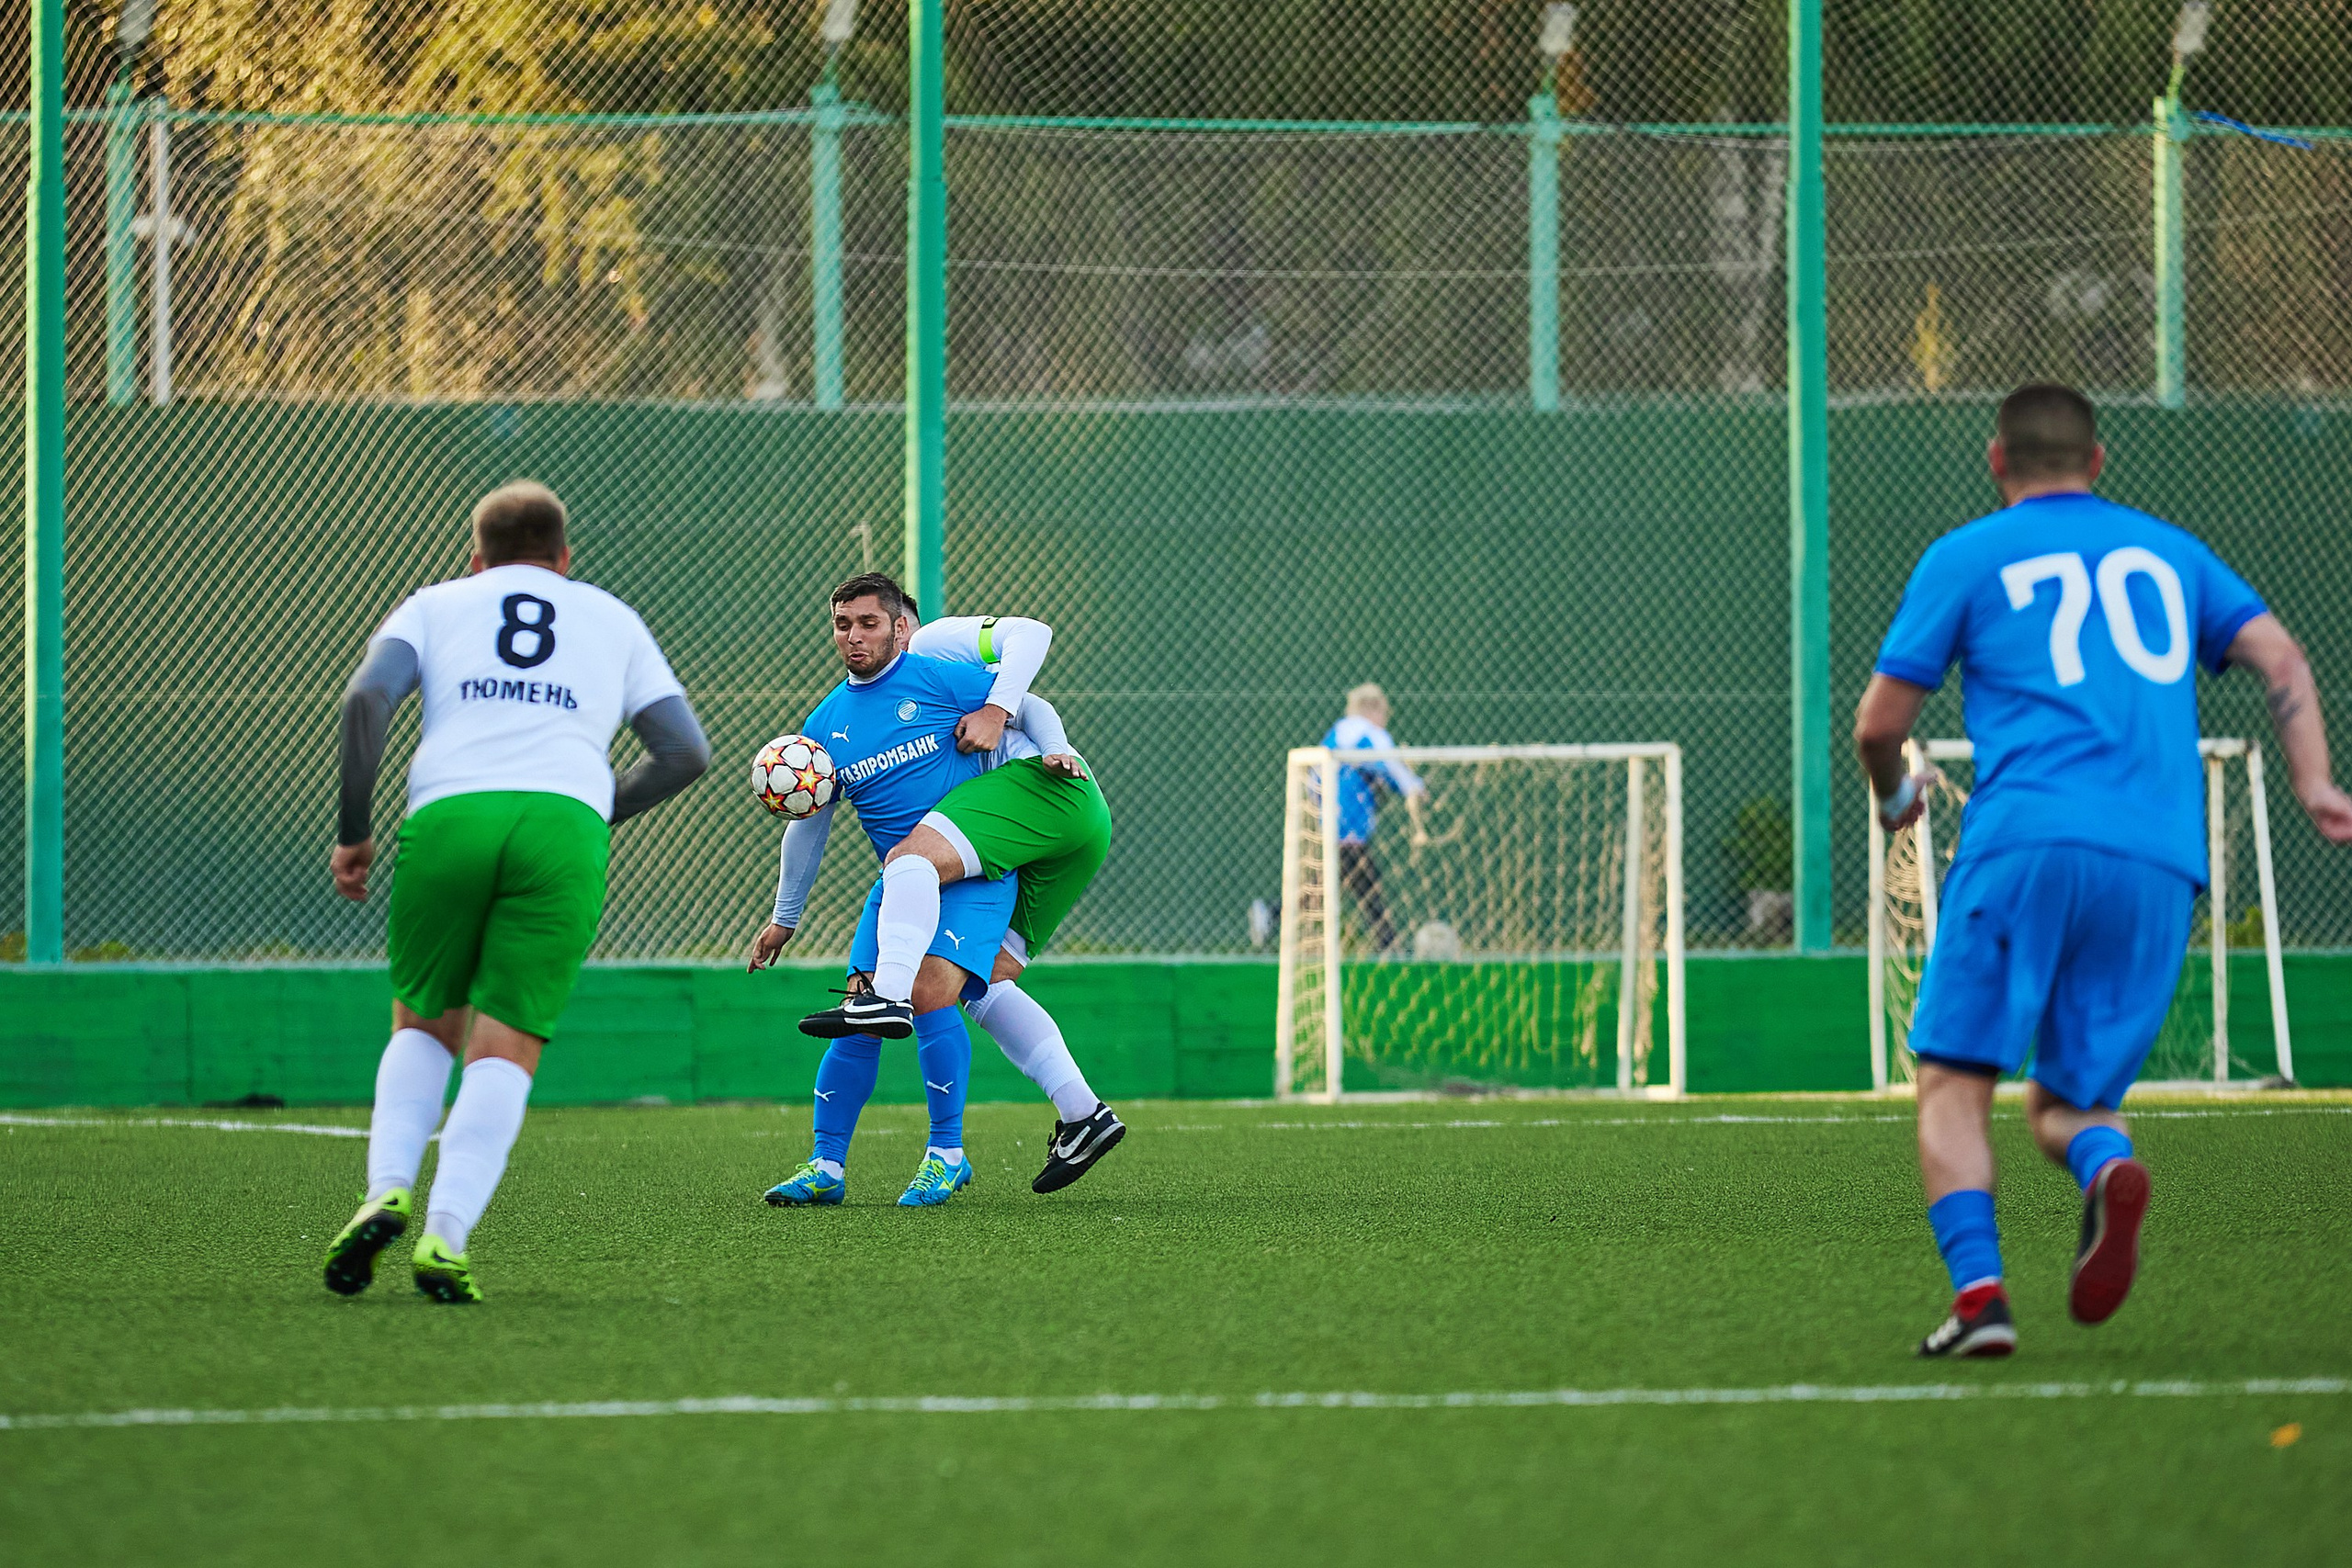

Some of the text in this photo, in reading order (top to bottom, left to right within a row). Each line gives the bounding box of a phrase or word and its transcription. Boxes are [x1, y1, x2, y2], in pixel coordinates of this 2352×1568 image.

[496, 593, 556, 669] 8
[2000, 546, 2190, 687] 70
[460, 678, 578, 709] ТЮМЕНЬ
